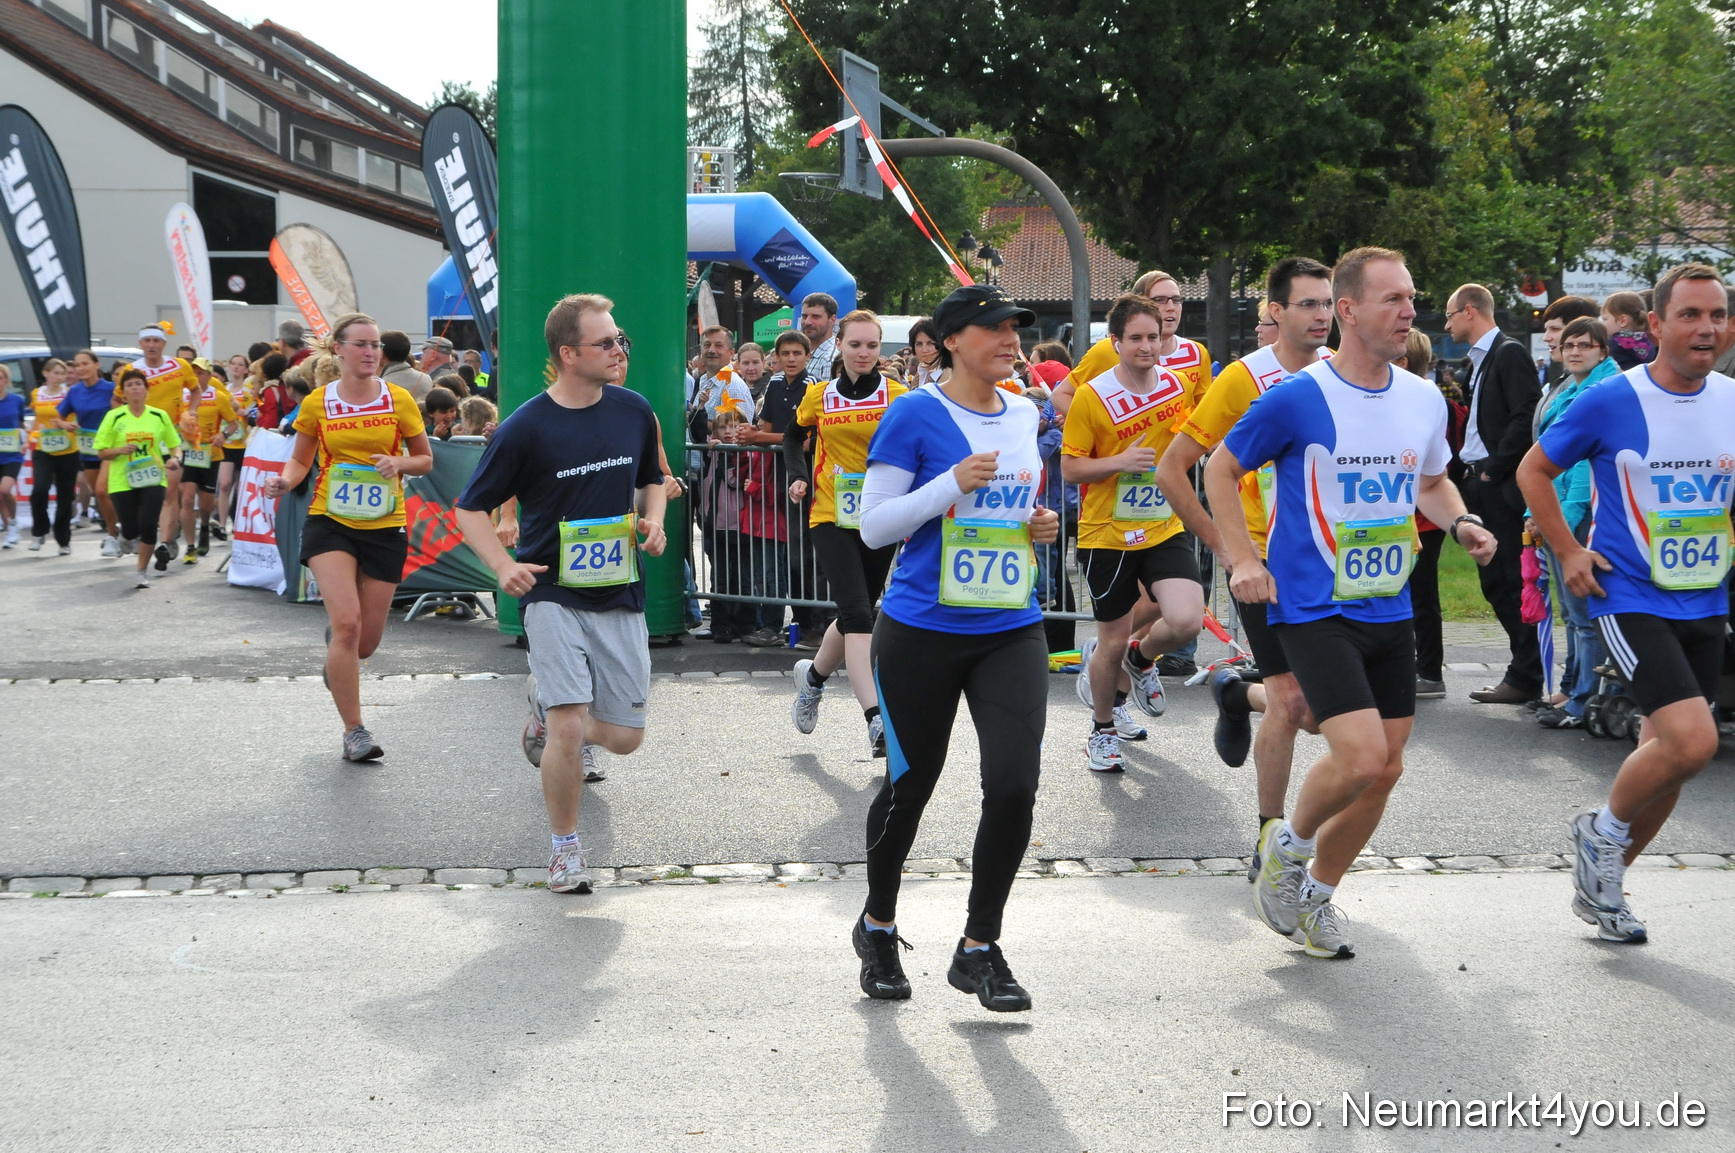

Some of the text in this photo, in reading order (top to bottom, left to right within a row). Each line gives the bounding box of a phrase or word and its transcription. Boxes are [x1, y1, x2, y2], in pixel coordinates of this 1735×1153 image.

[326, 417, 397, 432] MAX BÖGL
[823, 412, 884, 426] MAX BÖG
[1116, 400, 1184, 440] MAX BÖG
[556, 456, 633, 478] energiegeladen
[1336, 454, 1397, 467] expert
[1650, 459, 1713, 470] expert
[128, 467, 159, 483] 1316
[334, 482, 382, 507] 418
[974, 485, 1031, 509] TeVi
[1122, 486, 1166, 507] 429
[1337, 471, 1415, 505] TeVi
[1651, 474, 1732, 504] TeVi
[569, 540, 623, 571] 284
[1344, 544, 1402, 580] 680
[1660, 536, 1720, 570] 664
[953, 549, 1020, 586] 676
[962, 584, 989, 596] Peggy
[1357, 580, 1376, 588] Peter
